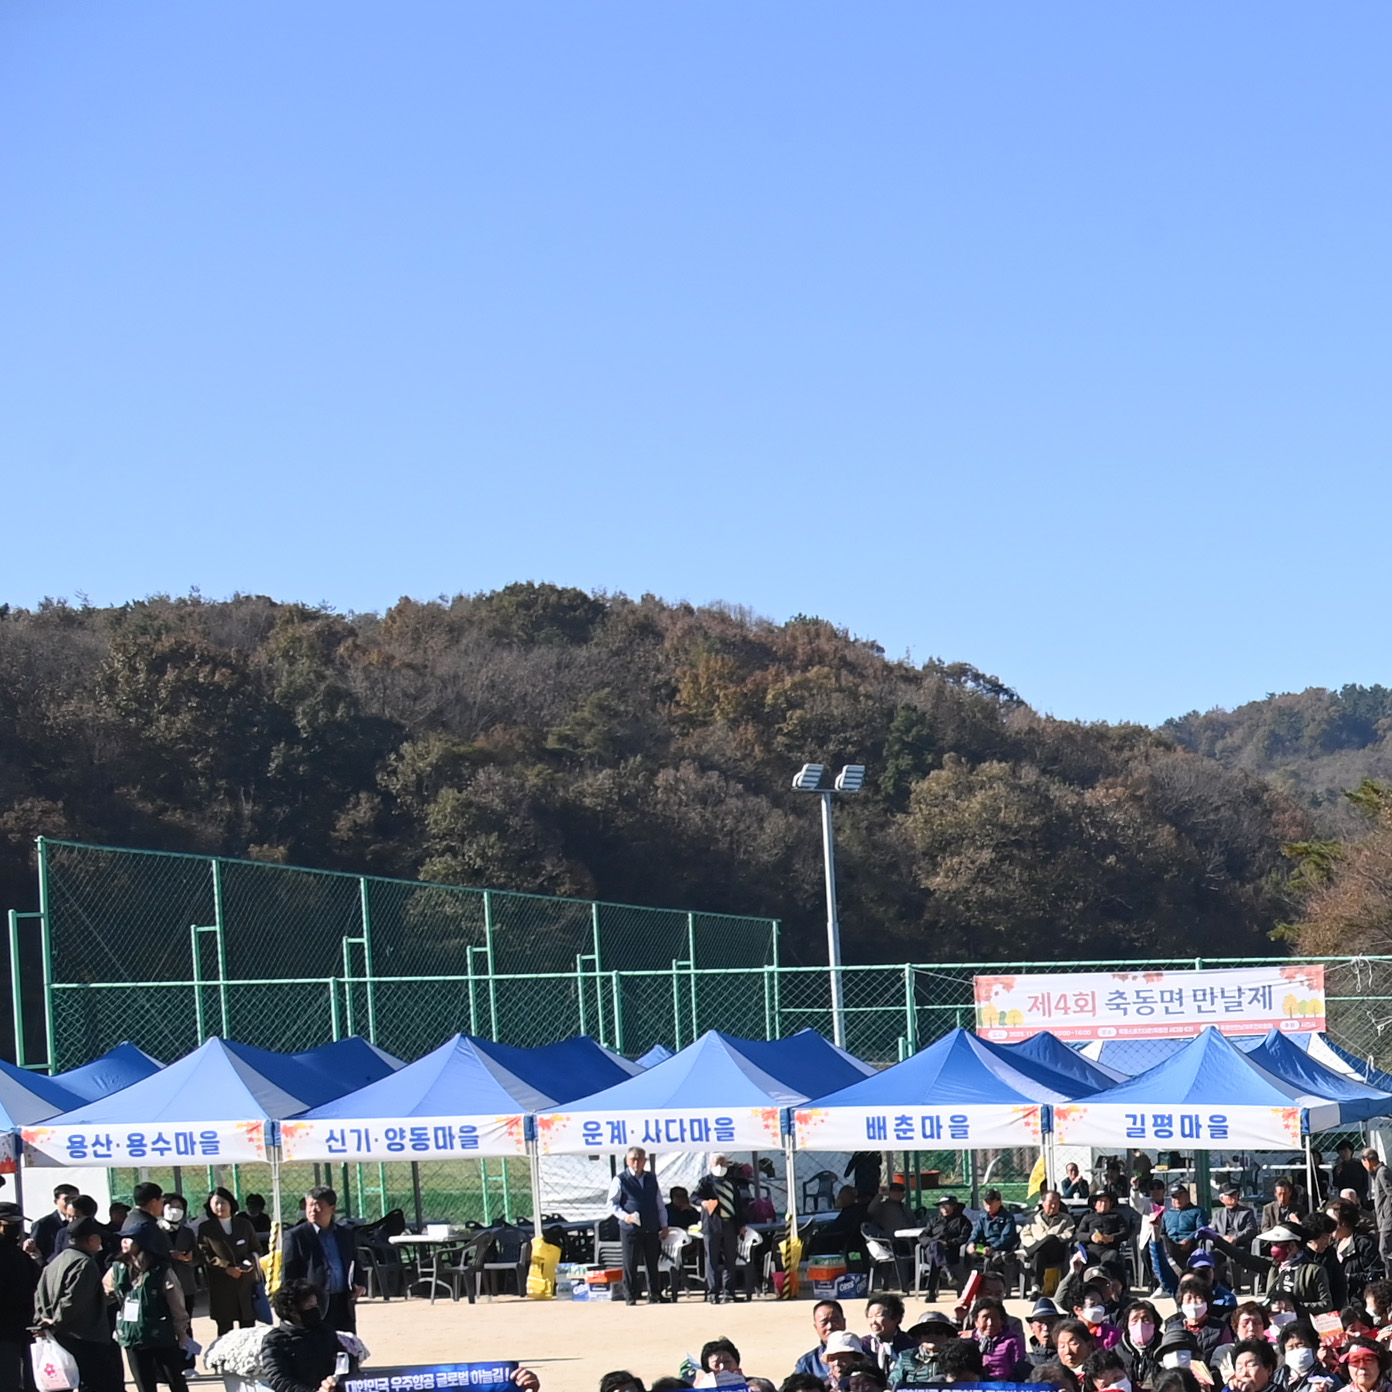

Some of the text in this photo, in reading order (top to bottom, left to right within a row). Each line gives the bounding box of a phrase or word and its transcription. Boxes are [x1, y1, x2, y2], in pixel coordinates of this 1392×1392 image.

[1028, 985, 1273, 1018] 제4회 축동면 만날제
[866, 1114, 970, 1141] 배춘마을
[1125, 1113, 1229, 1140] 길평마을
[390, 1374, 433, 1391] 우주항공
[436, 1372, 467, 1388] 글로벌
[470, 1369, 509, 1385] 하늘길!
